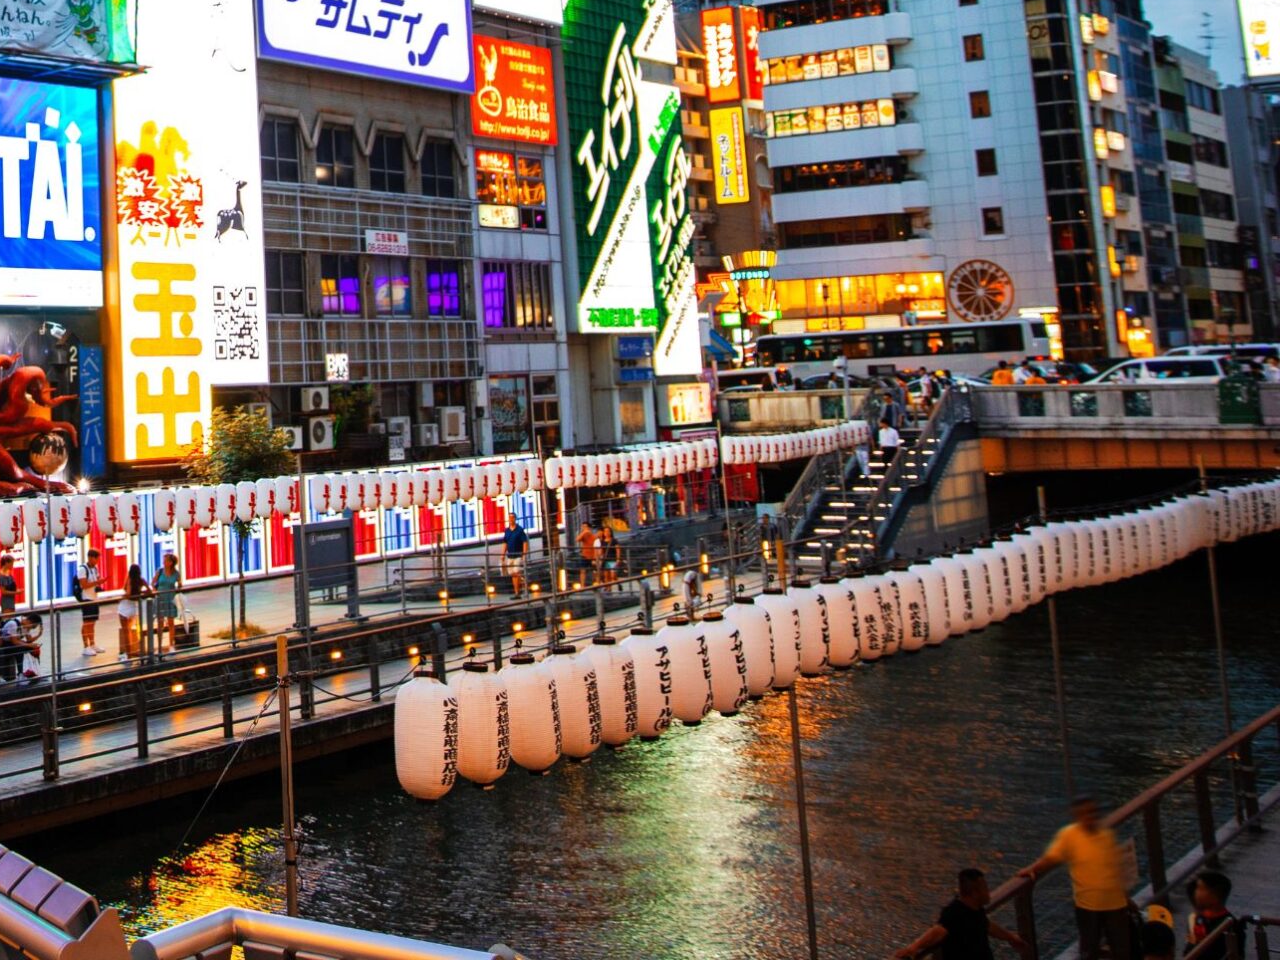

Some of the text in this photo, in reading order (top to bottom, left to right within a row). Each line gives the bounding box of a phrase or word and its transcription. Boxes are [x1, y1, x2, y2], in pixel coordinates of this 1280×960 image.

[81, 347, 102, 464] ペンギンバー
[130, 261, 203, 460] 玉出
